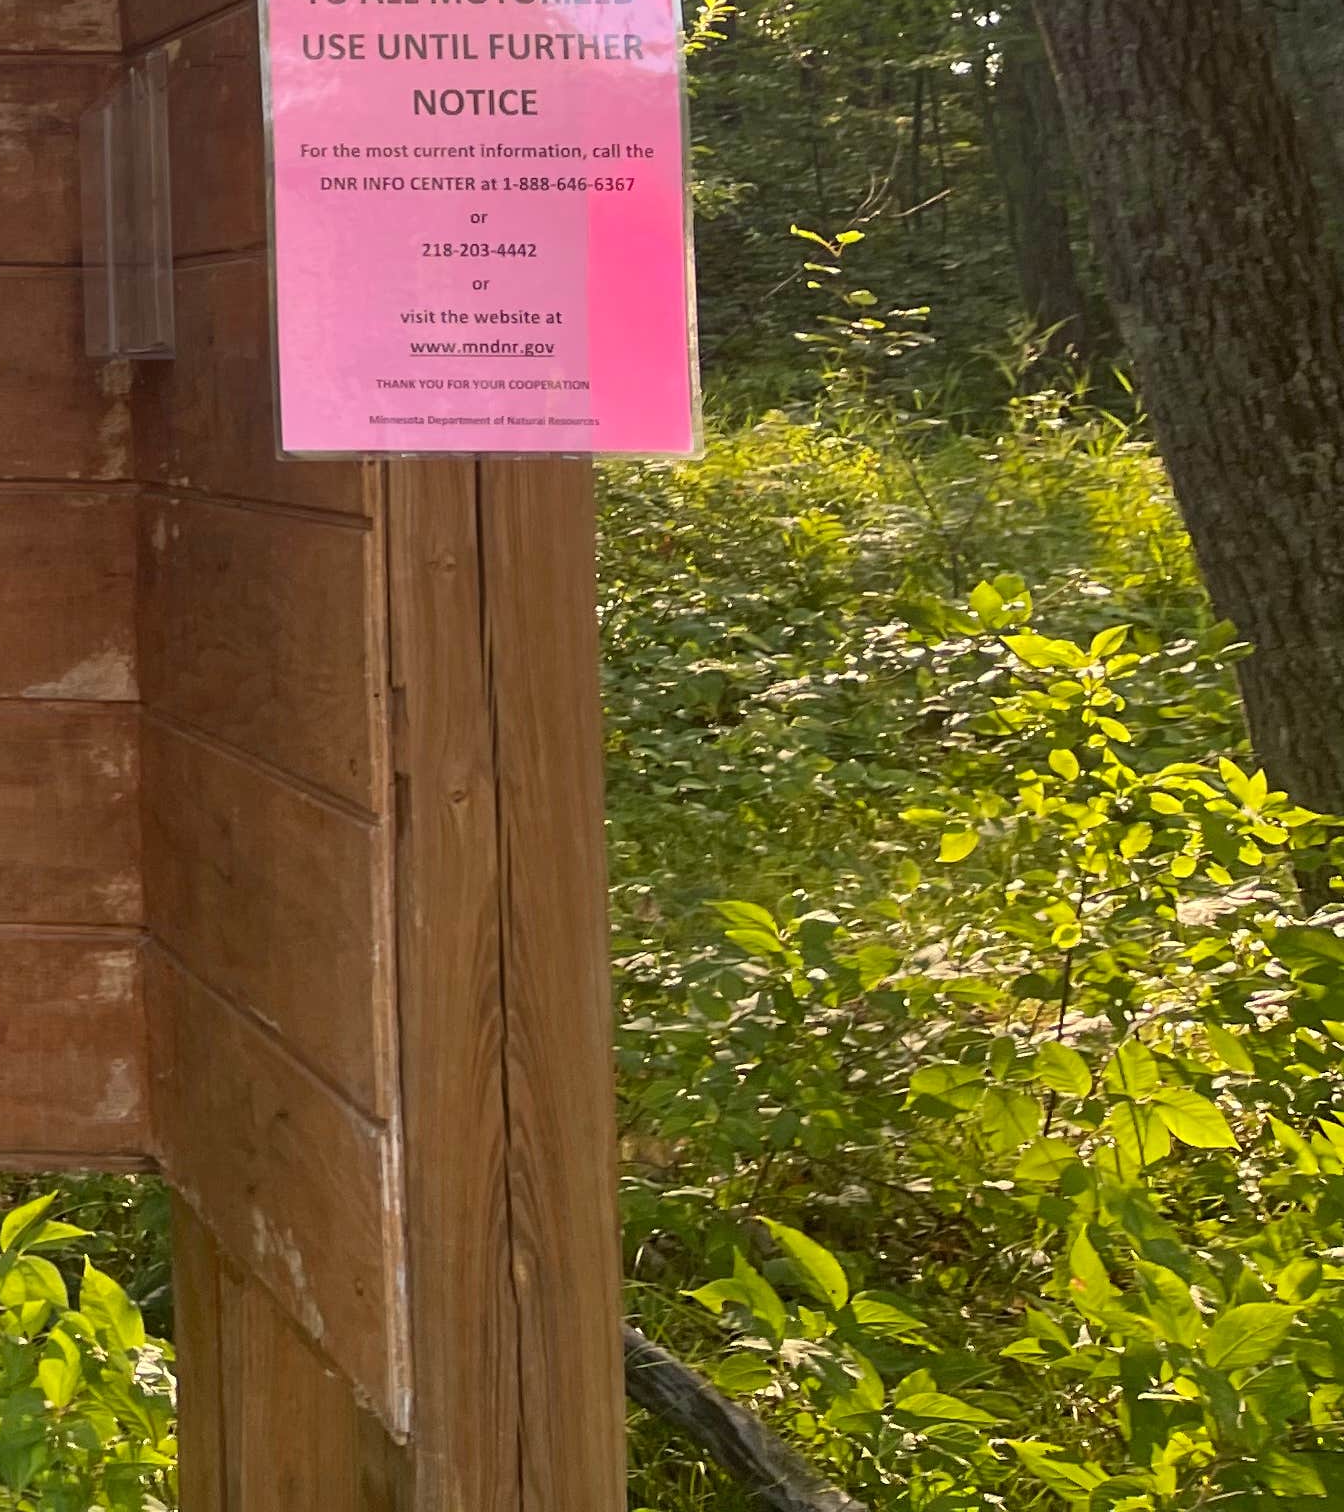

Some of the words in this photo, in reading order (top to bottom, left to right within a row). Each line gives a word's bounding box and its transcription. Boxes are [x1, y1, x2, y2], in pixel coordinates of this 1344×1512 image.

[303, 34, 365, 60] USE
[378, 34, 478, 60] UNTIL
[490, 34, 643, 60] FURTHER
[413, 89, 538, 116] NOTICE
[300, 144, 328, 158] For
[333, 144, 360, 158] the
[366, 144, 408, 158] most
[413, 144, 476, 158] current
[480, 144, 587, 161] information,
[592, 144, 621, 158] call
[626, 144, 654, 158] the
[320, 176, 358, 191] DNR
[363, 176, 404, 191] INFO
[410, 176, 476, 191] CENTER
[481, 176, 498, 191] at
[502, 176, 634, 191] 1-888-646-6367
[470, 212, 488, 224] or
[422, 244, 537, 258] 218-203-4442
[472, 278, 490, 290] or
[400, 310, 434, 324] visit
[441, 310, 468, 324] the
[473, 310, 540, 324] website
[546, 310, 562, 324] at
[410, 341, 554, 356] www.mndnr.gov
[376, 379, 415, 390] THANK
[419, 379, 443, 390] YOU
[448, 379, 469, 390] FOR
[473, 379, 505, 390] YOUR
[509, 379, 589, 390] COOPERATION
[370, 415, 424, 426] Minnesota
[427, 415, 490, 428] Department
[494, 415, 505, 426] of
[507, 415, 544, 426] Natural
[548, 415, 600, 426] Resources
